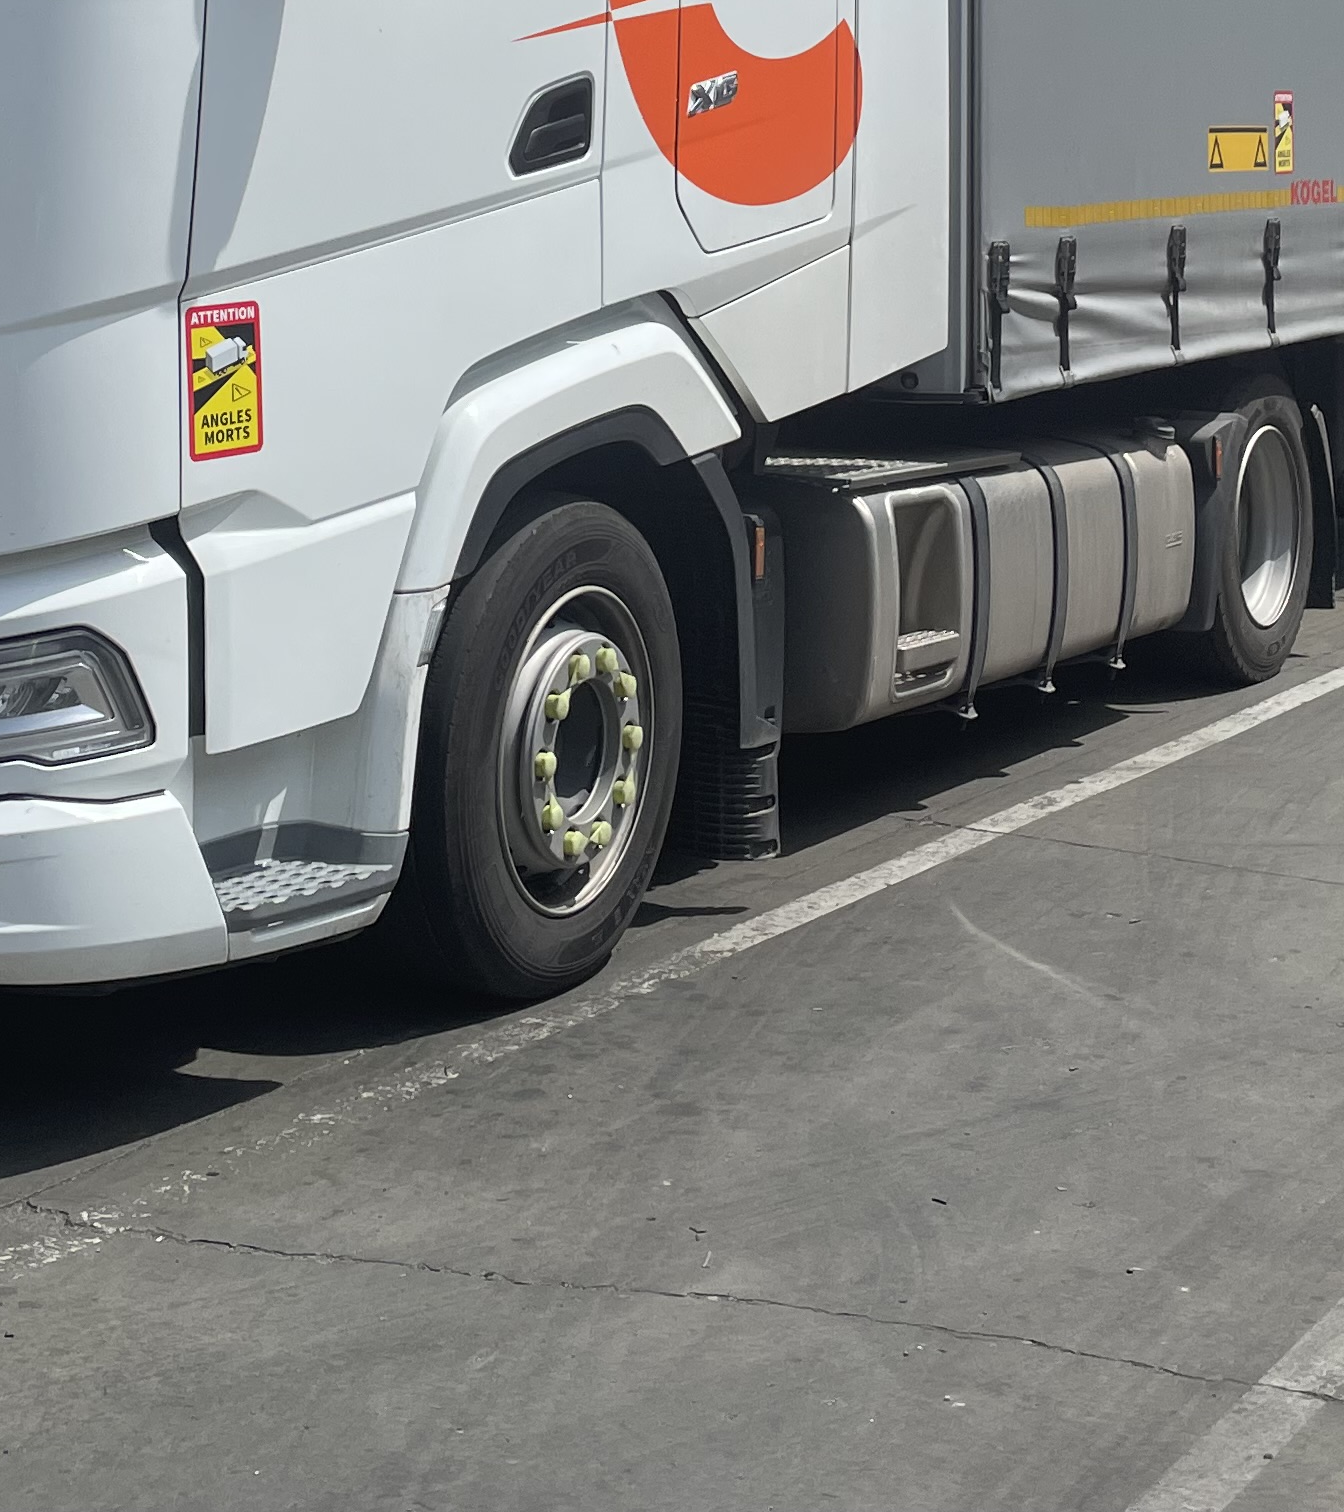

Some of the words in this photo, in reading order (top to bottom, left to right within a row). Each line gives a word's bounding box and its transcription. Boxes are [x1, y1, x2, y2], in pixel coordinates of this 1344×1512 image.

[190, 306, 256, 325] ATTENTION
[201, 408, 252, 429] ANGLES
[204, 425, 250, 446] MORTS
